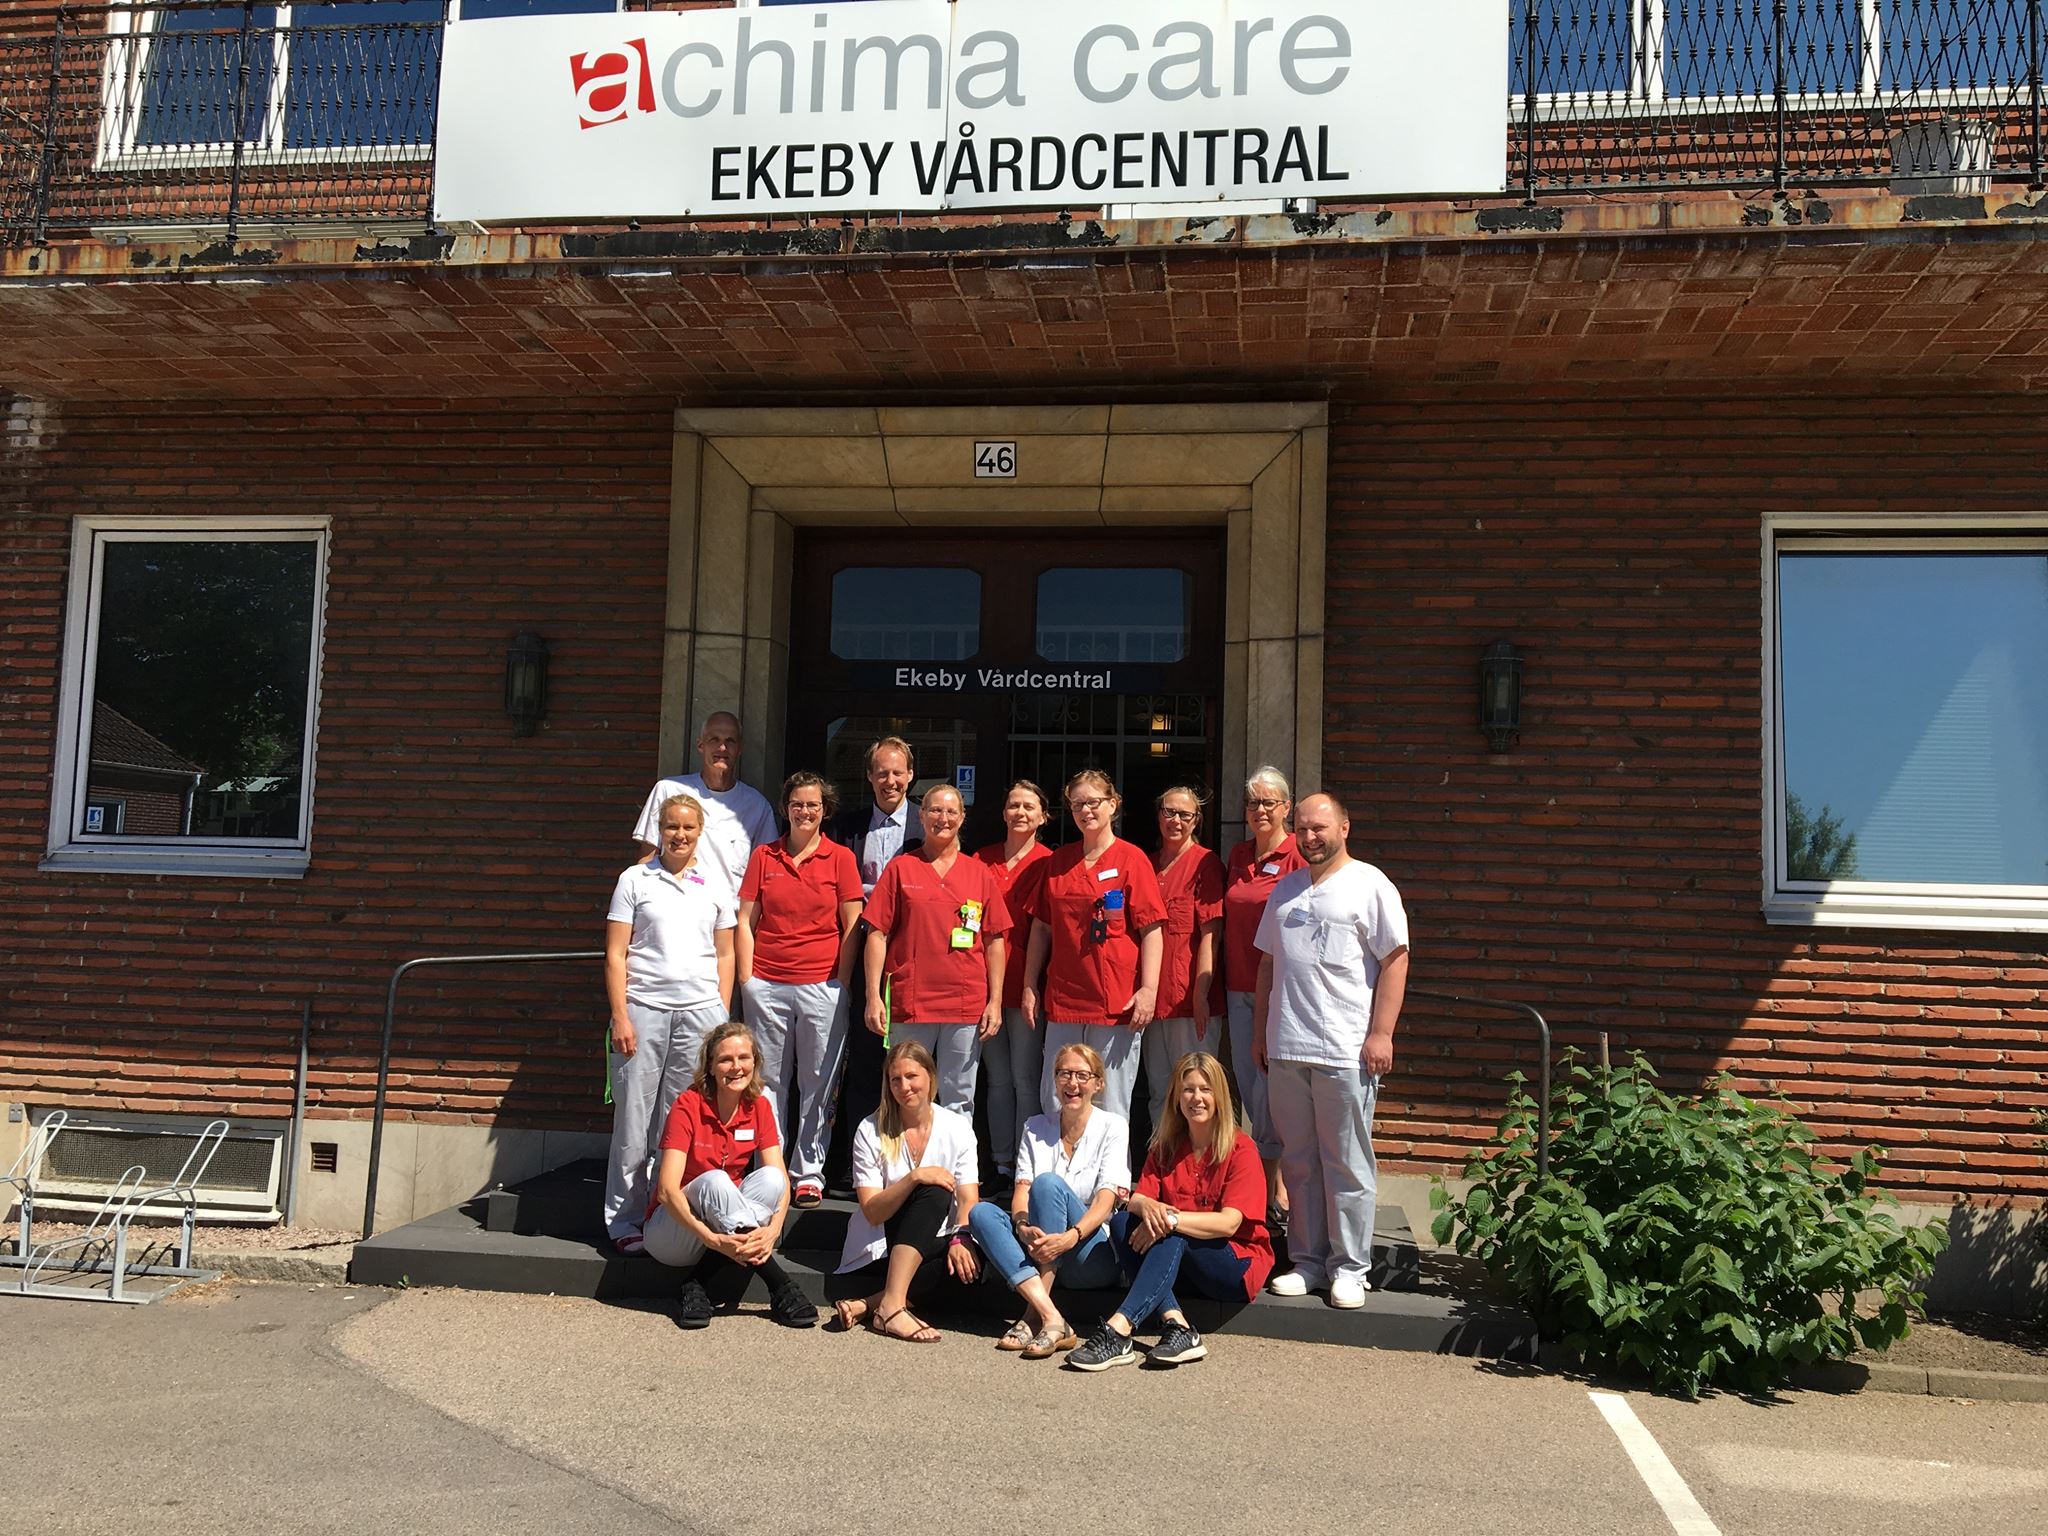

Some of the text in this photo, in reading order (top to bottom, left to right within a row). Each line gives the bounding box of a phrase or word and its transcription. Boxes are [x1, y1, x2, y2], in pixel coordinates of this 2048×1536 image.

[570, 13, 1352, 130] achima care
[711, 121, 1350, 201] EKEBY VÅRDCENTRAL
[977, 446, 1014, 473] 46
[895, 667, 1112, 691] Ekeby Vårdcentral
